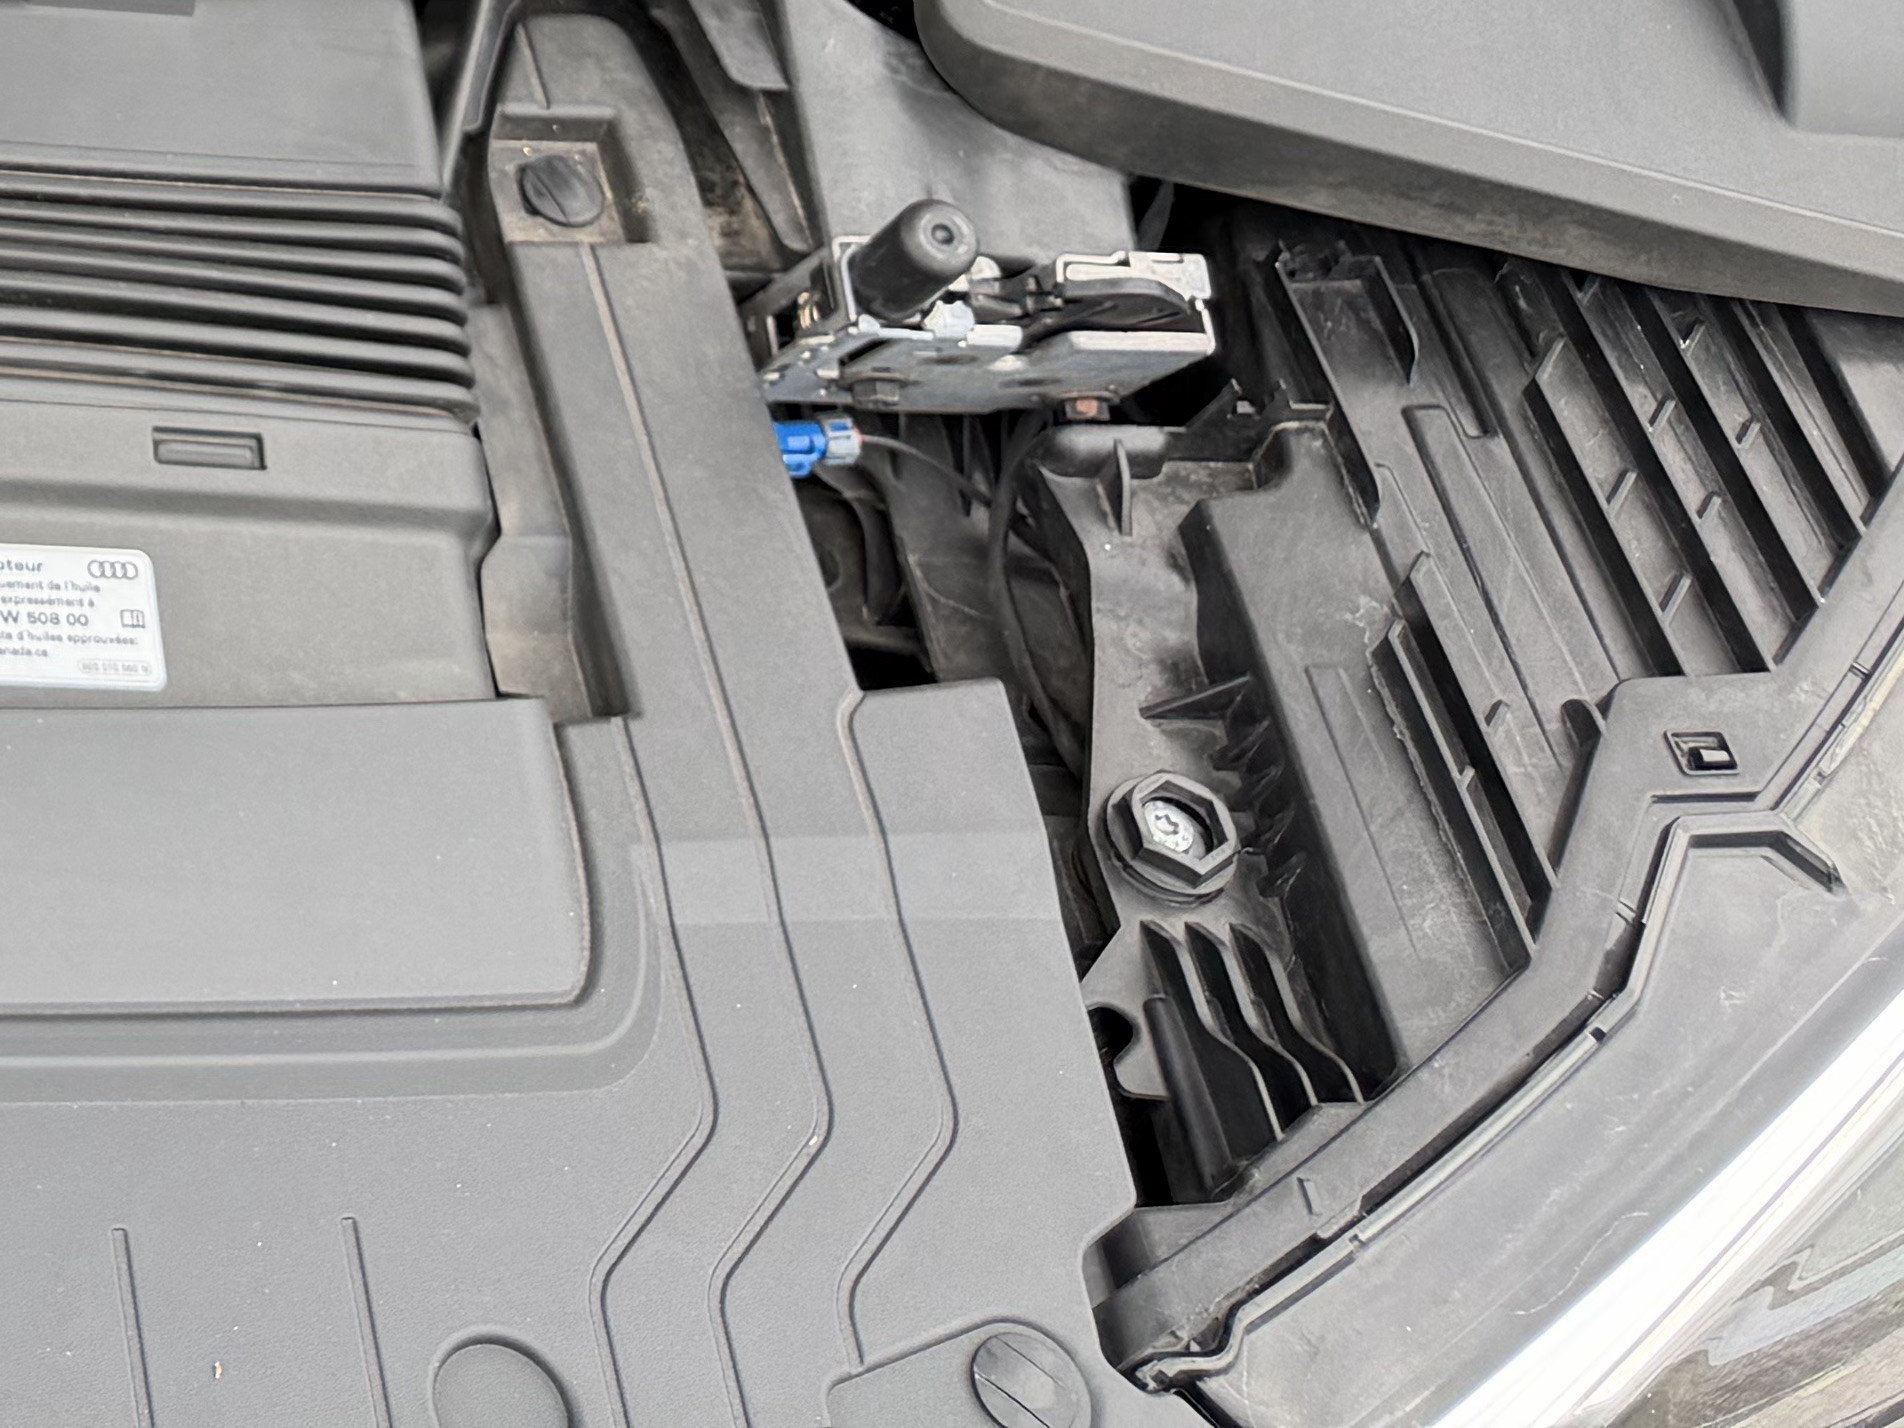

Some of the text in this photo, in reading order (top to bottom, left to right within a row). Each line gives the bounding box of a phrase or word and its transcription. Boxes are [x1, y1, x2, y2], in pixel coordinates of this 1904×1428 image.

[47, 580, 61, 591] de
[27, 611, 60, 625] 508
[66, 613, 89, 626] 00
